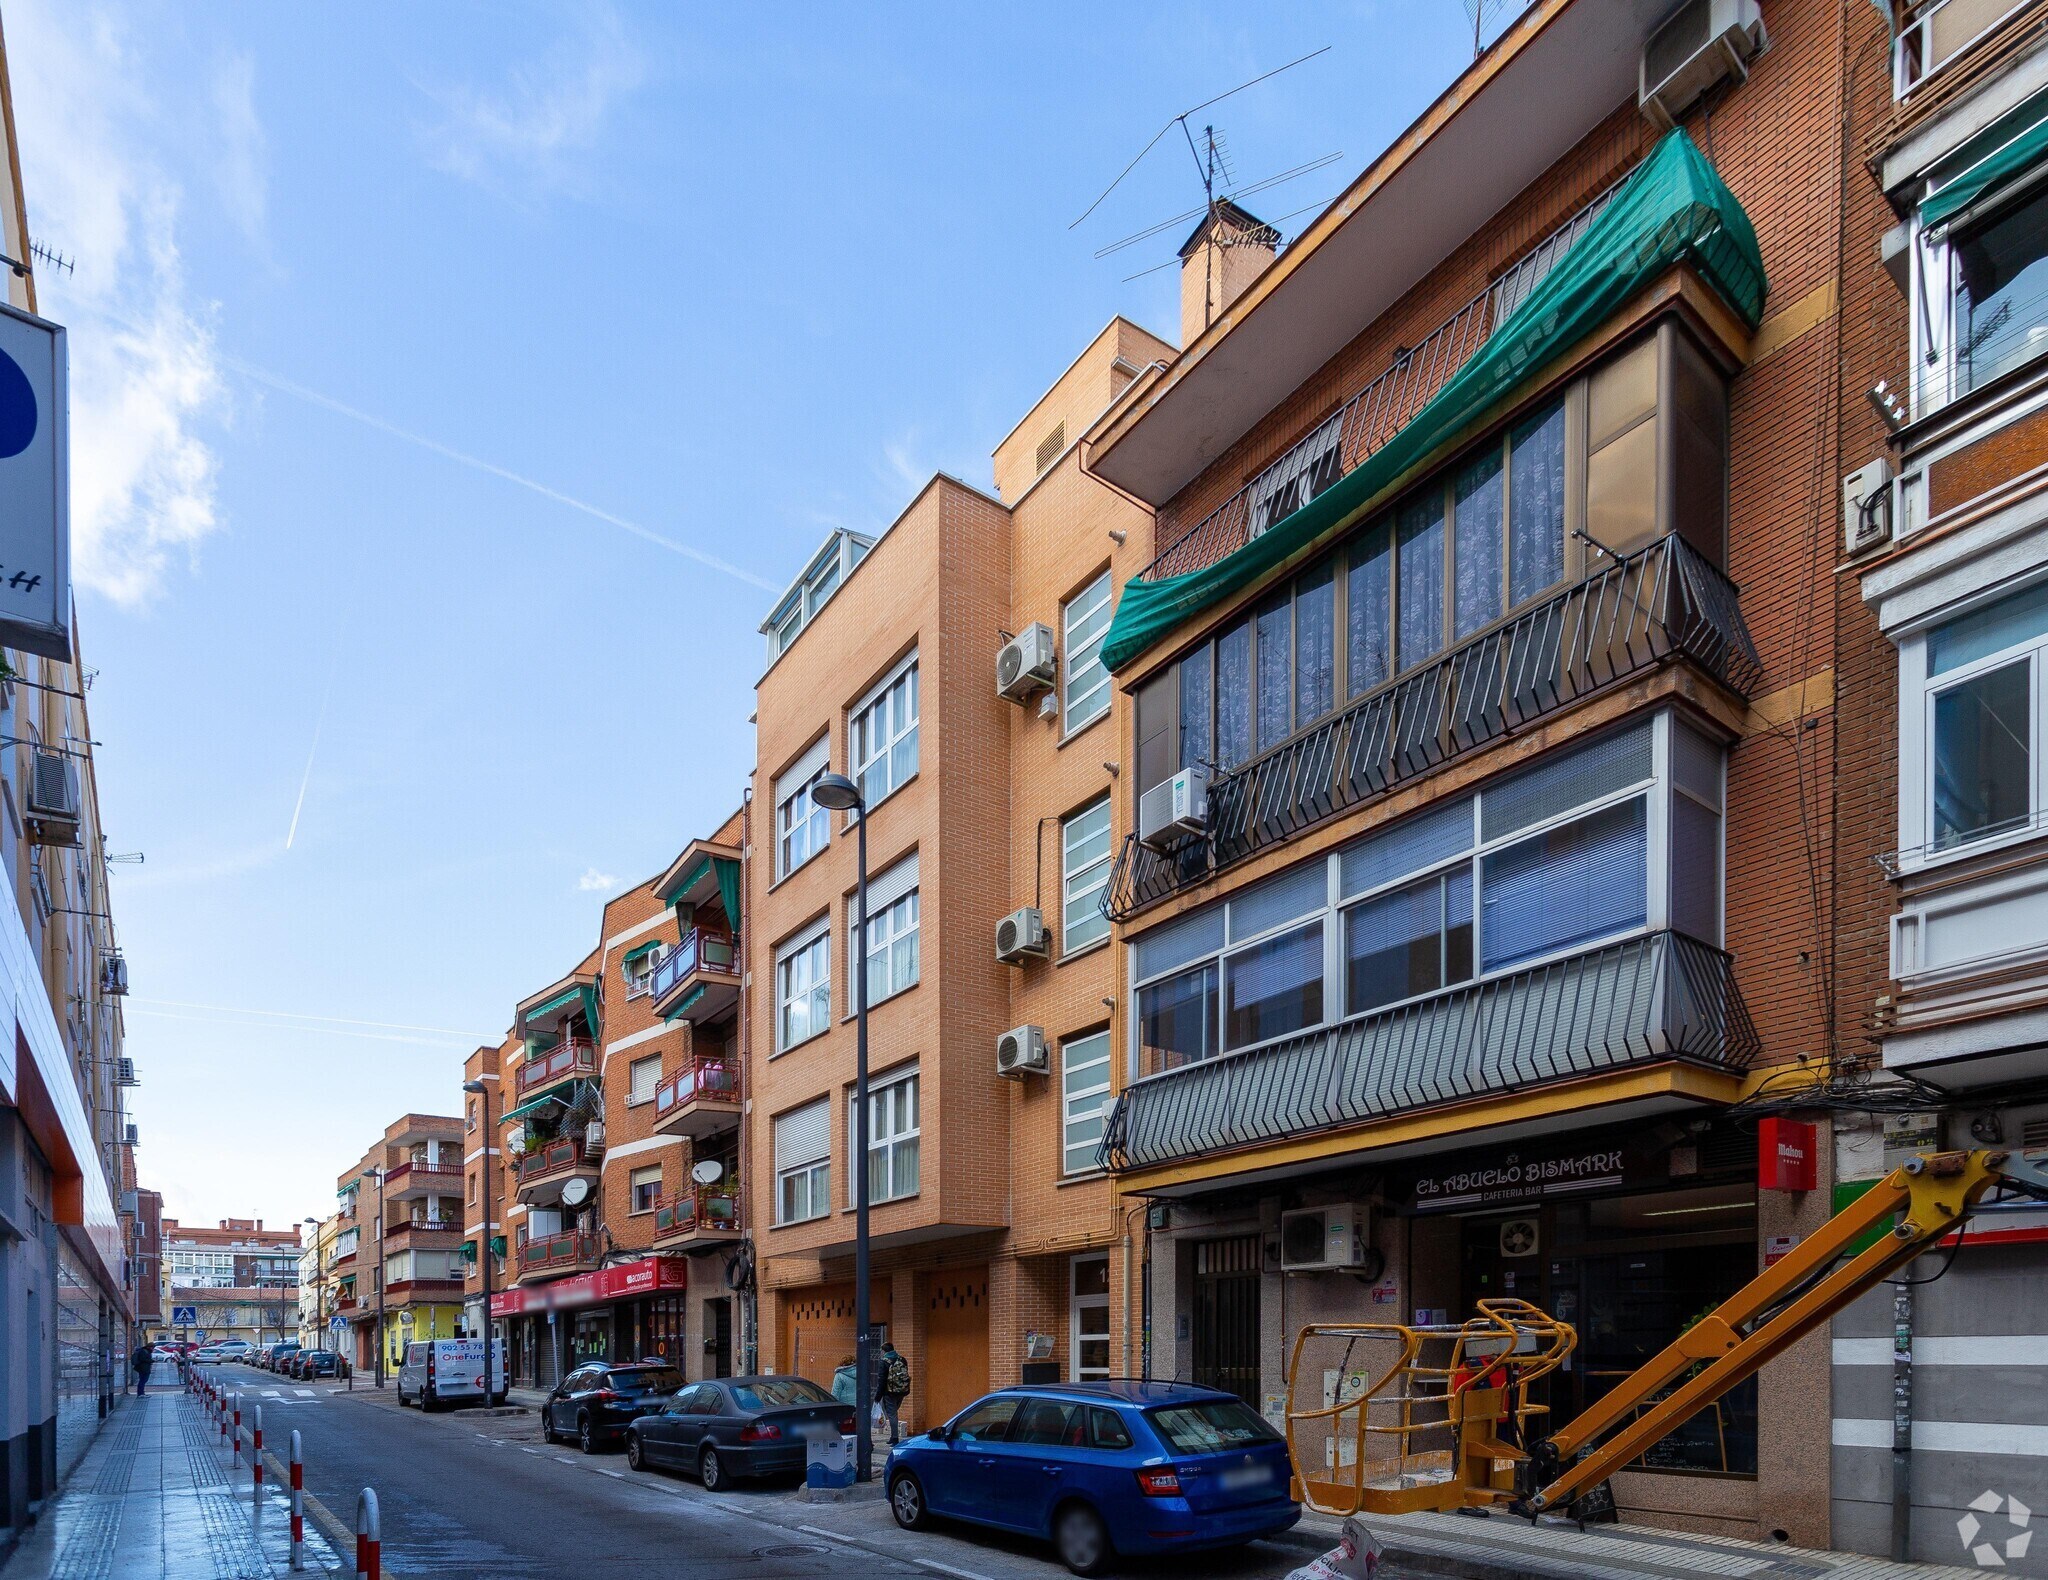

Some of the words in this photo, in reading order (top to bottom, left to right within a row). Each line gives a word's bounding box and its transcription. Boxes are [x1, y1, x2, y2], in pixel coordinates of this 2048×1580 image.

[1778, 1143, 1803, 1158] Mahou
[1416, 1179, 1439, 1195] EL
[1443, 1165, 1521, 1193] ABUELO
[1525, 1150, 1624, 1182] BISMARK
[1483, 1188, 1523, 1201] CAFETERIA
[1525, 1186, 1542, 1197] BAR
[1100, 1268, 1109, 1283] 1
[442, 1344, 458, 1352] 902
